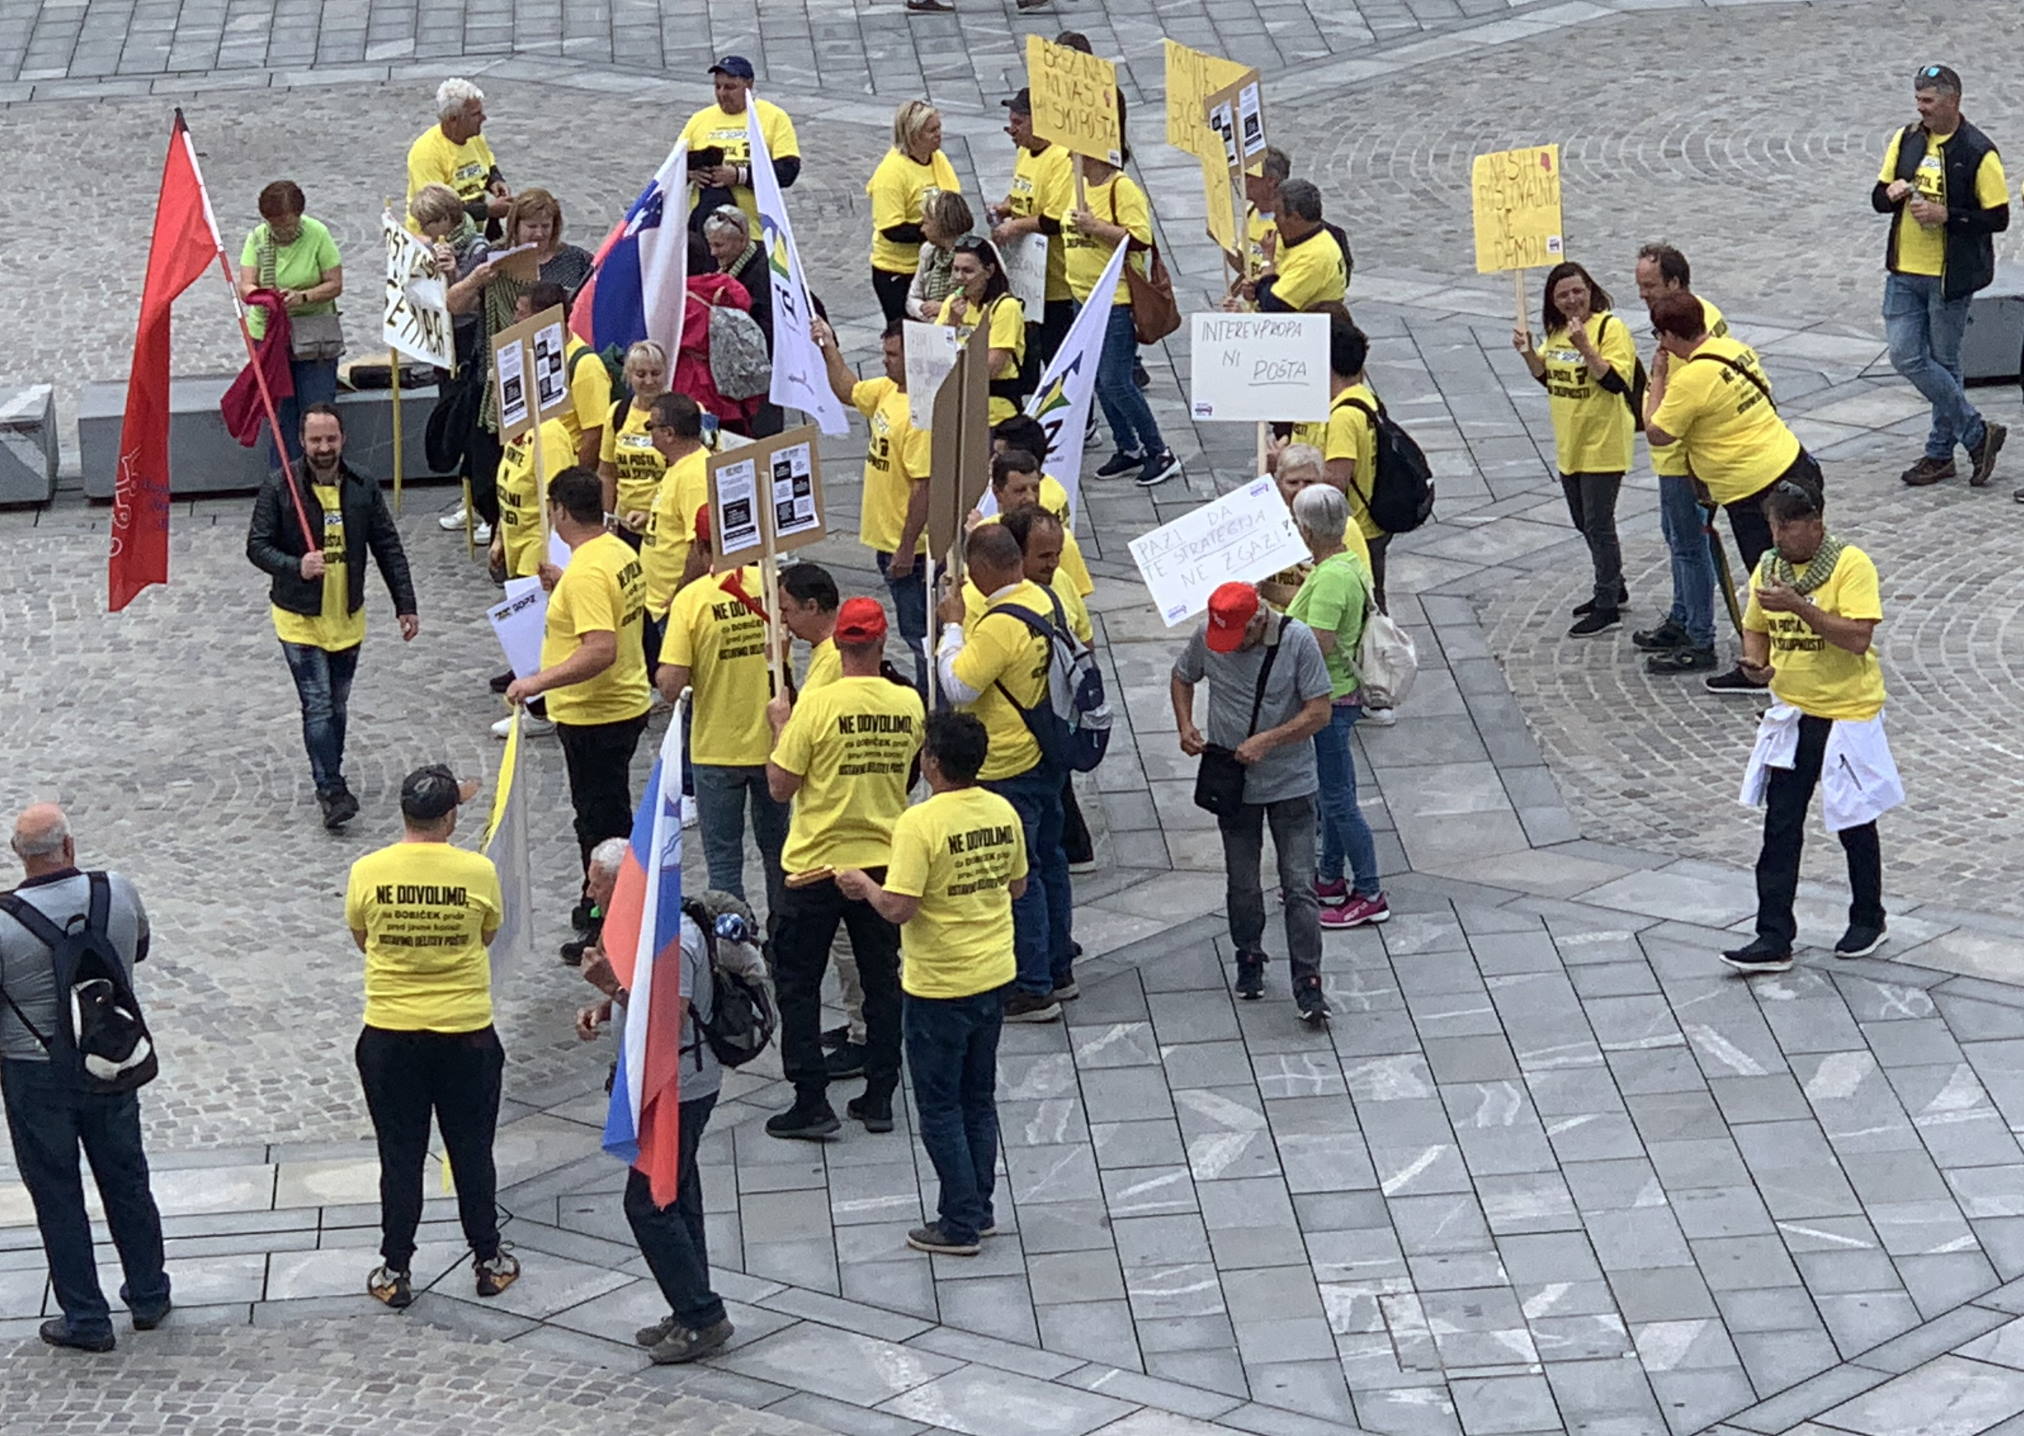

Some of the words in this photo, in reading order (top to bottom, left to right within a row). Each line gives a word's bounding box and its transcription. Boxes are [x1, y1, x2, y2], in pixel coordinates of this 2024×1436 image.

[1222, 348, 1241, 368] NI
[838, 714, 855, 735] NE
[947, 833, 965, 855] NE
[376, 885, 393, 905] NE
